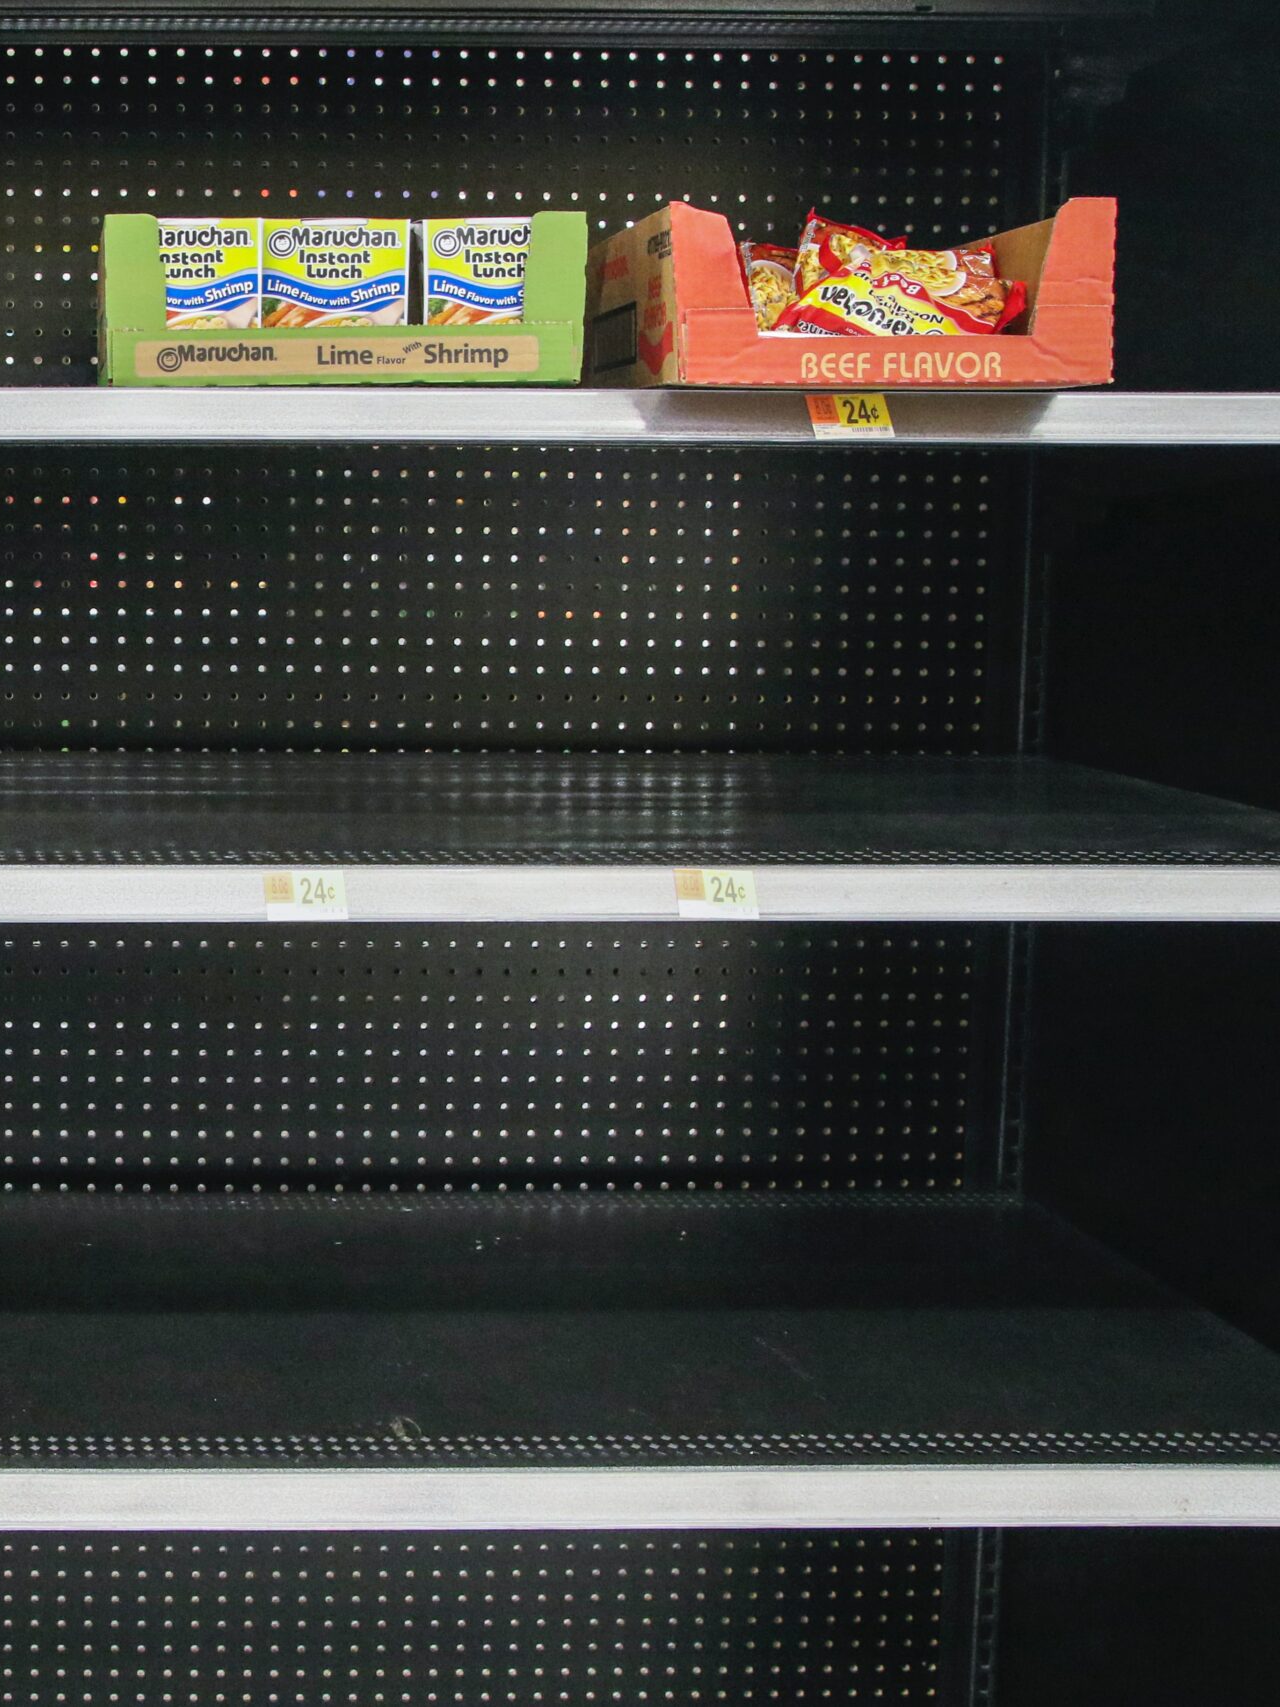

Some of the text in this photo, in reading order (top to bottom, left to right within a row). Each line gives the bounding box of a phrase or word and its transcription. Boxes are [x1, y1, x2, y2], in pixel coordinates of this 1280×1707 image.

[159, 226, 249, 247] aruchan
[292, 226, 397, 247] Maruchan
[457, 225, 531, 246] Maruch
[160, 250, 224, 266] nstant
[299, 249, 371, 266] Instant
[465, 249, 528, 265] Instan
[166, 265, 216, 279] unch
[307, 265, 363, 279] Lunch
[167, 280, 254, 306] vor with Shrimp
[267, 279, 401, 306] Lime Flavor with Shrimp
[433, 279, 466, 298] Lime
[466, 292, 496, 306] Flavor
[496, 295, 517, 306] with
[177, 343, 275, 362] Maruchan
[317, 341, 509, 368] Lime Flavor With Shrimp
[801, 351, 1003, 379] BEEF FLAVOR
[842, 399, 880, 424] 24¢
[300, 877, 336, 904] 24¢
[711, 876, 746, 903] 24¢
